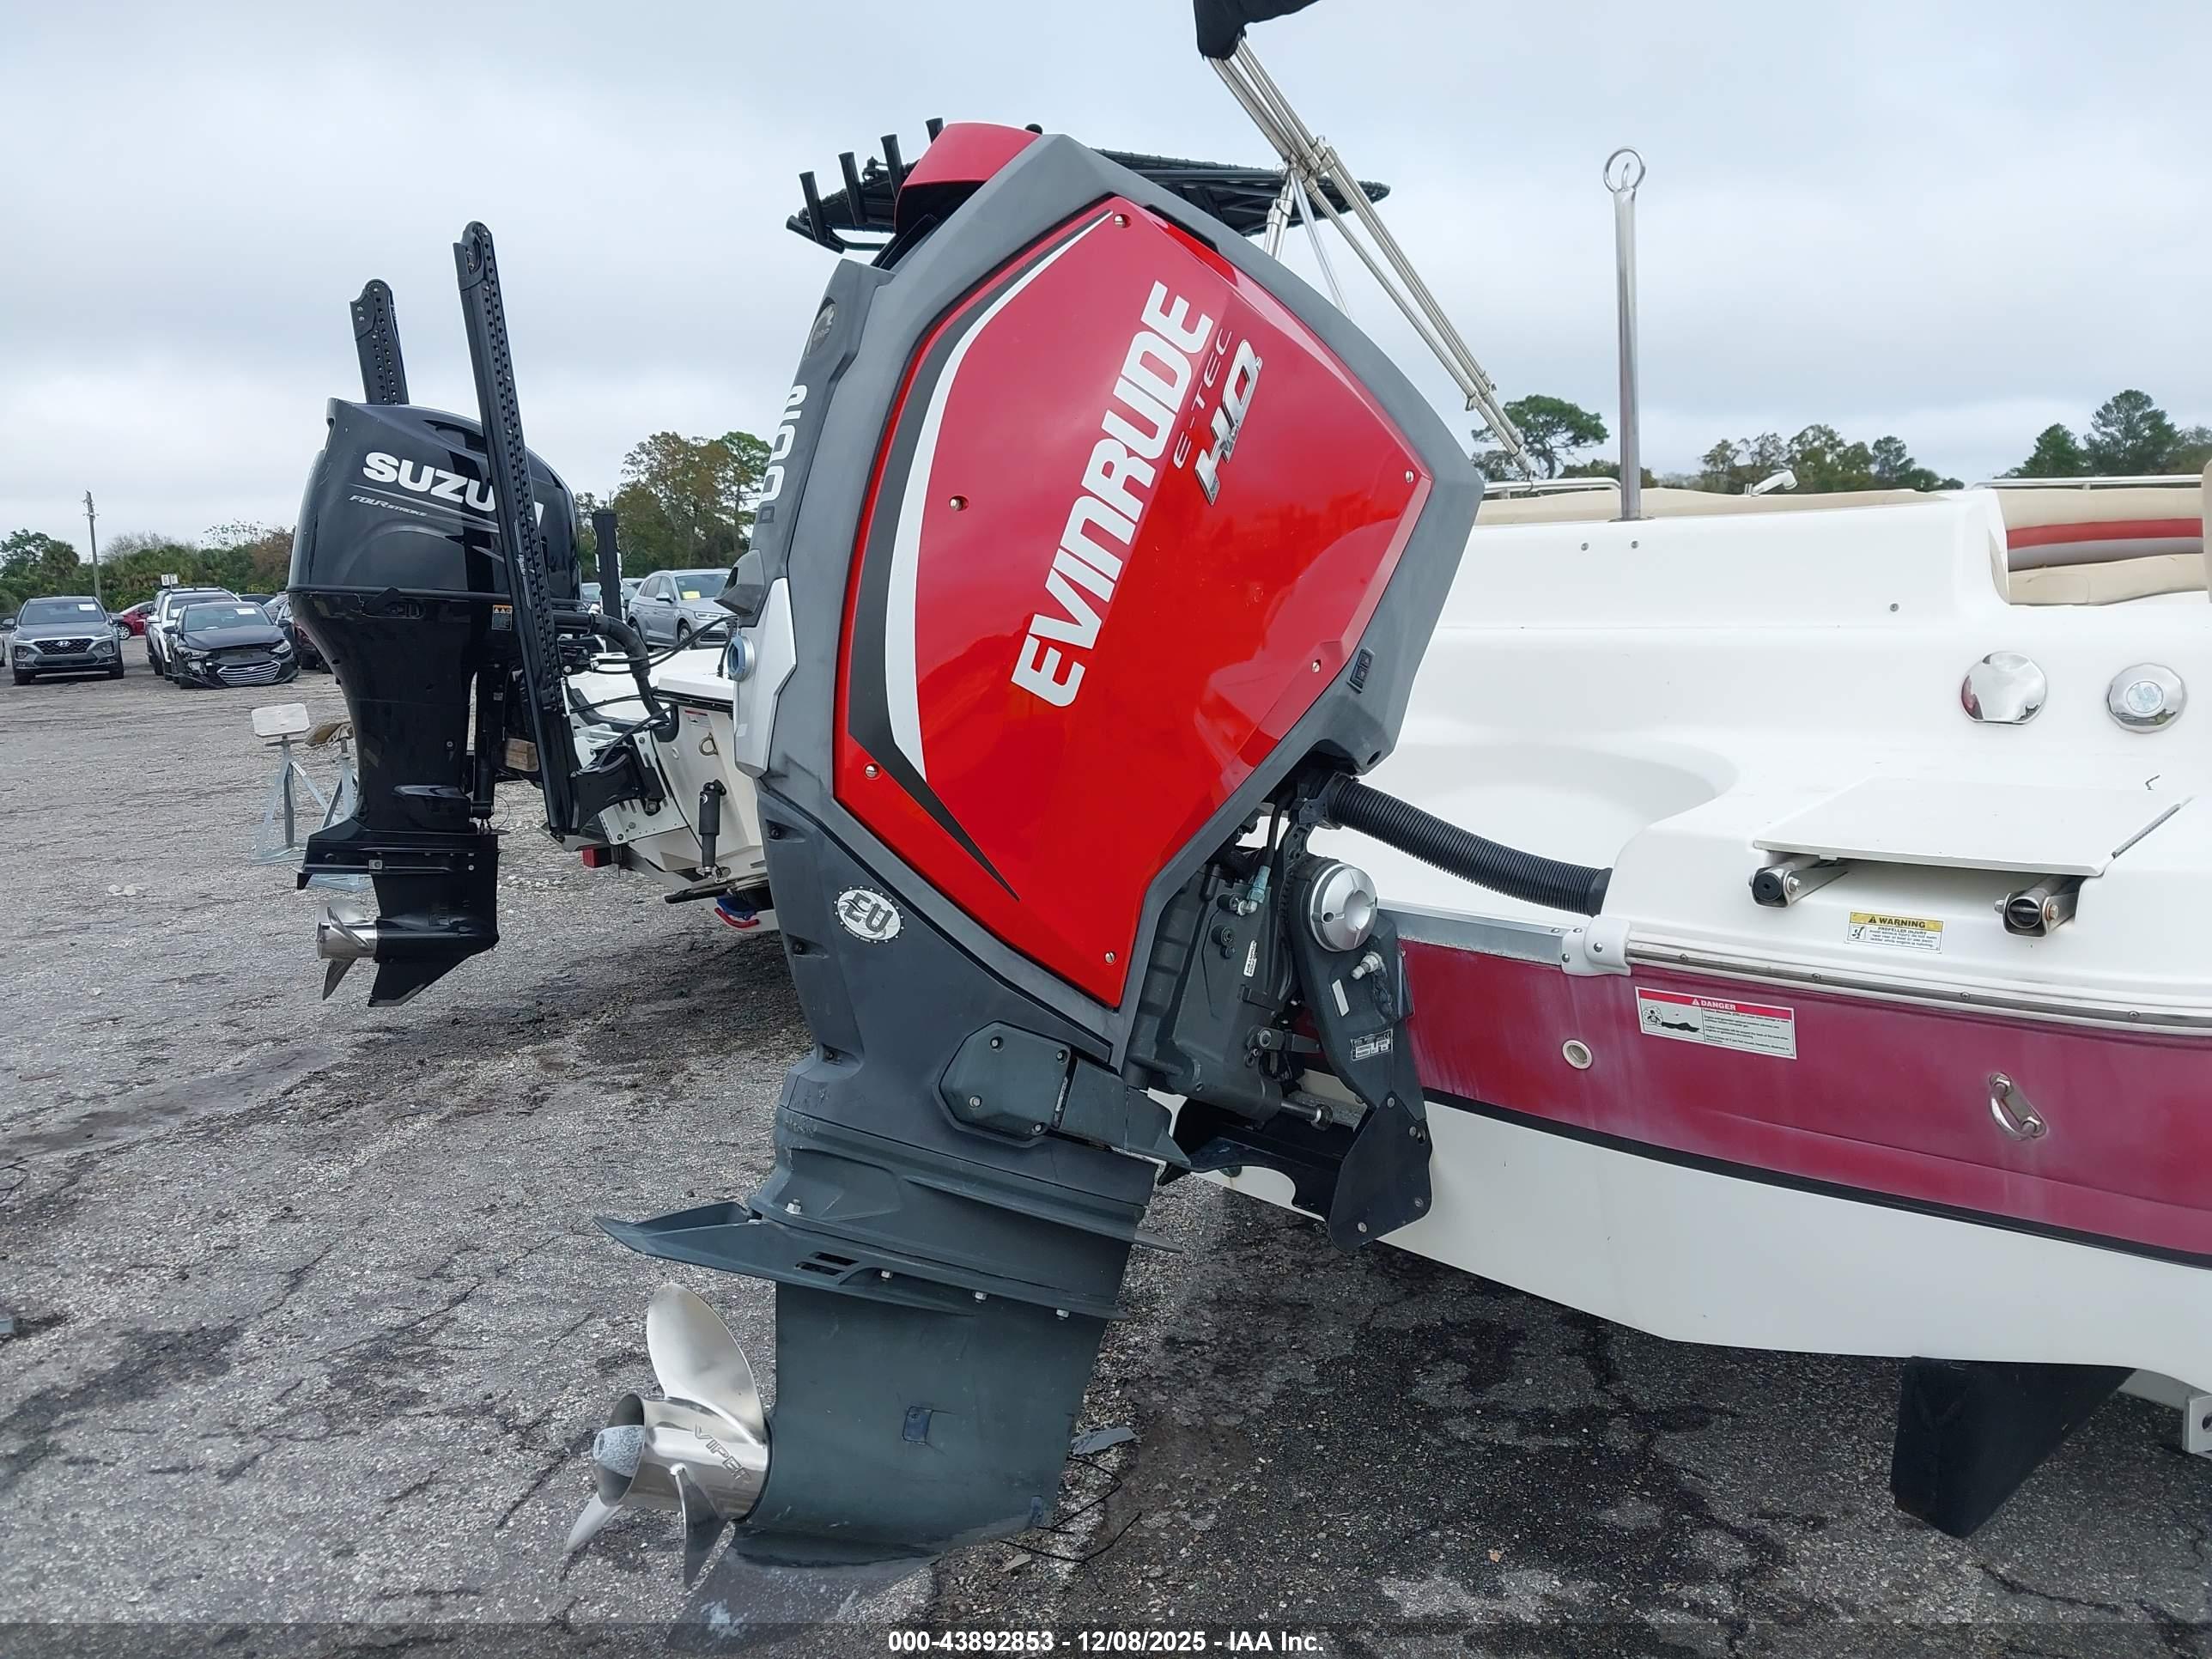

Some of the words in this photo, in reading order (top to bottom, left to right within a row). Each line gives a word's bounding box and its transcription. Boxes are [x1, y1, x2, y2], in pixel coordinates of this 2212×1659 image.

[1173, 328, 1232, 469] E-TEC
[362, 452, 544, 528] SUZU
[1012, 281, 1213, 706] EVINRUDE
[1879, 917, 1926, 928] WARNING
[1700, 999, 1736, 1012] DANGER
[696, 1423, 750, 1484] VIPER
